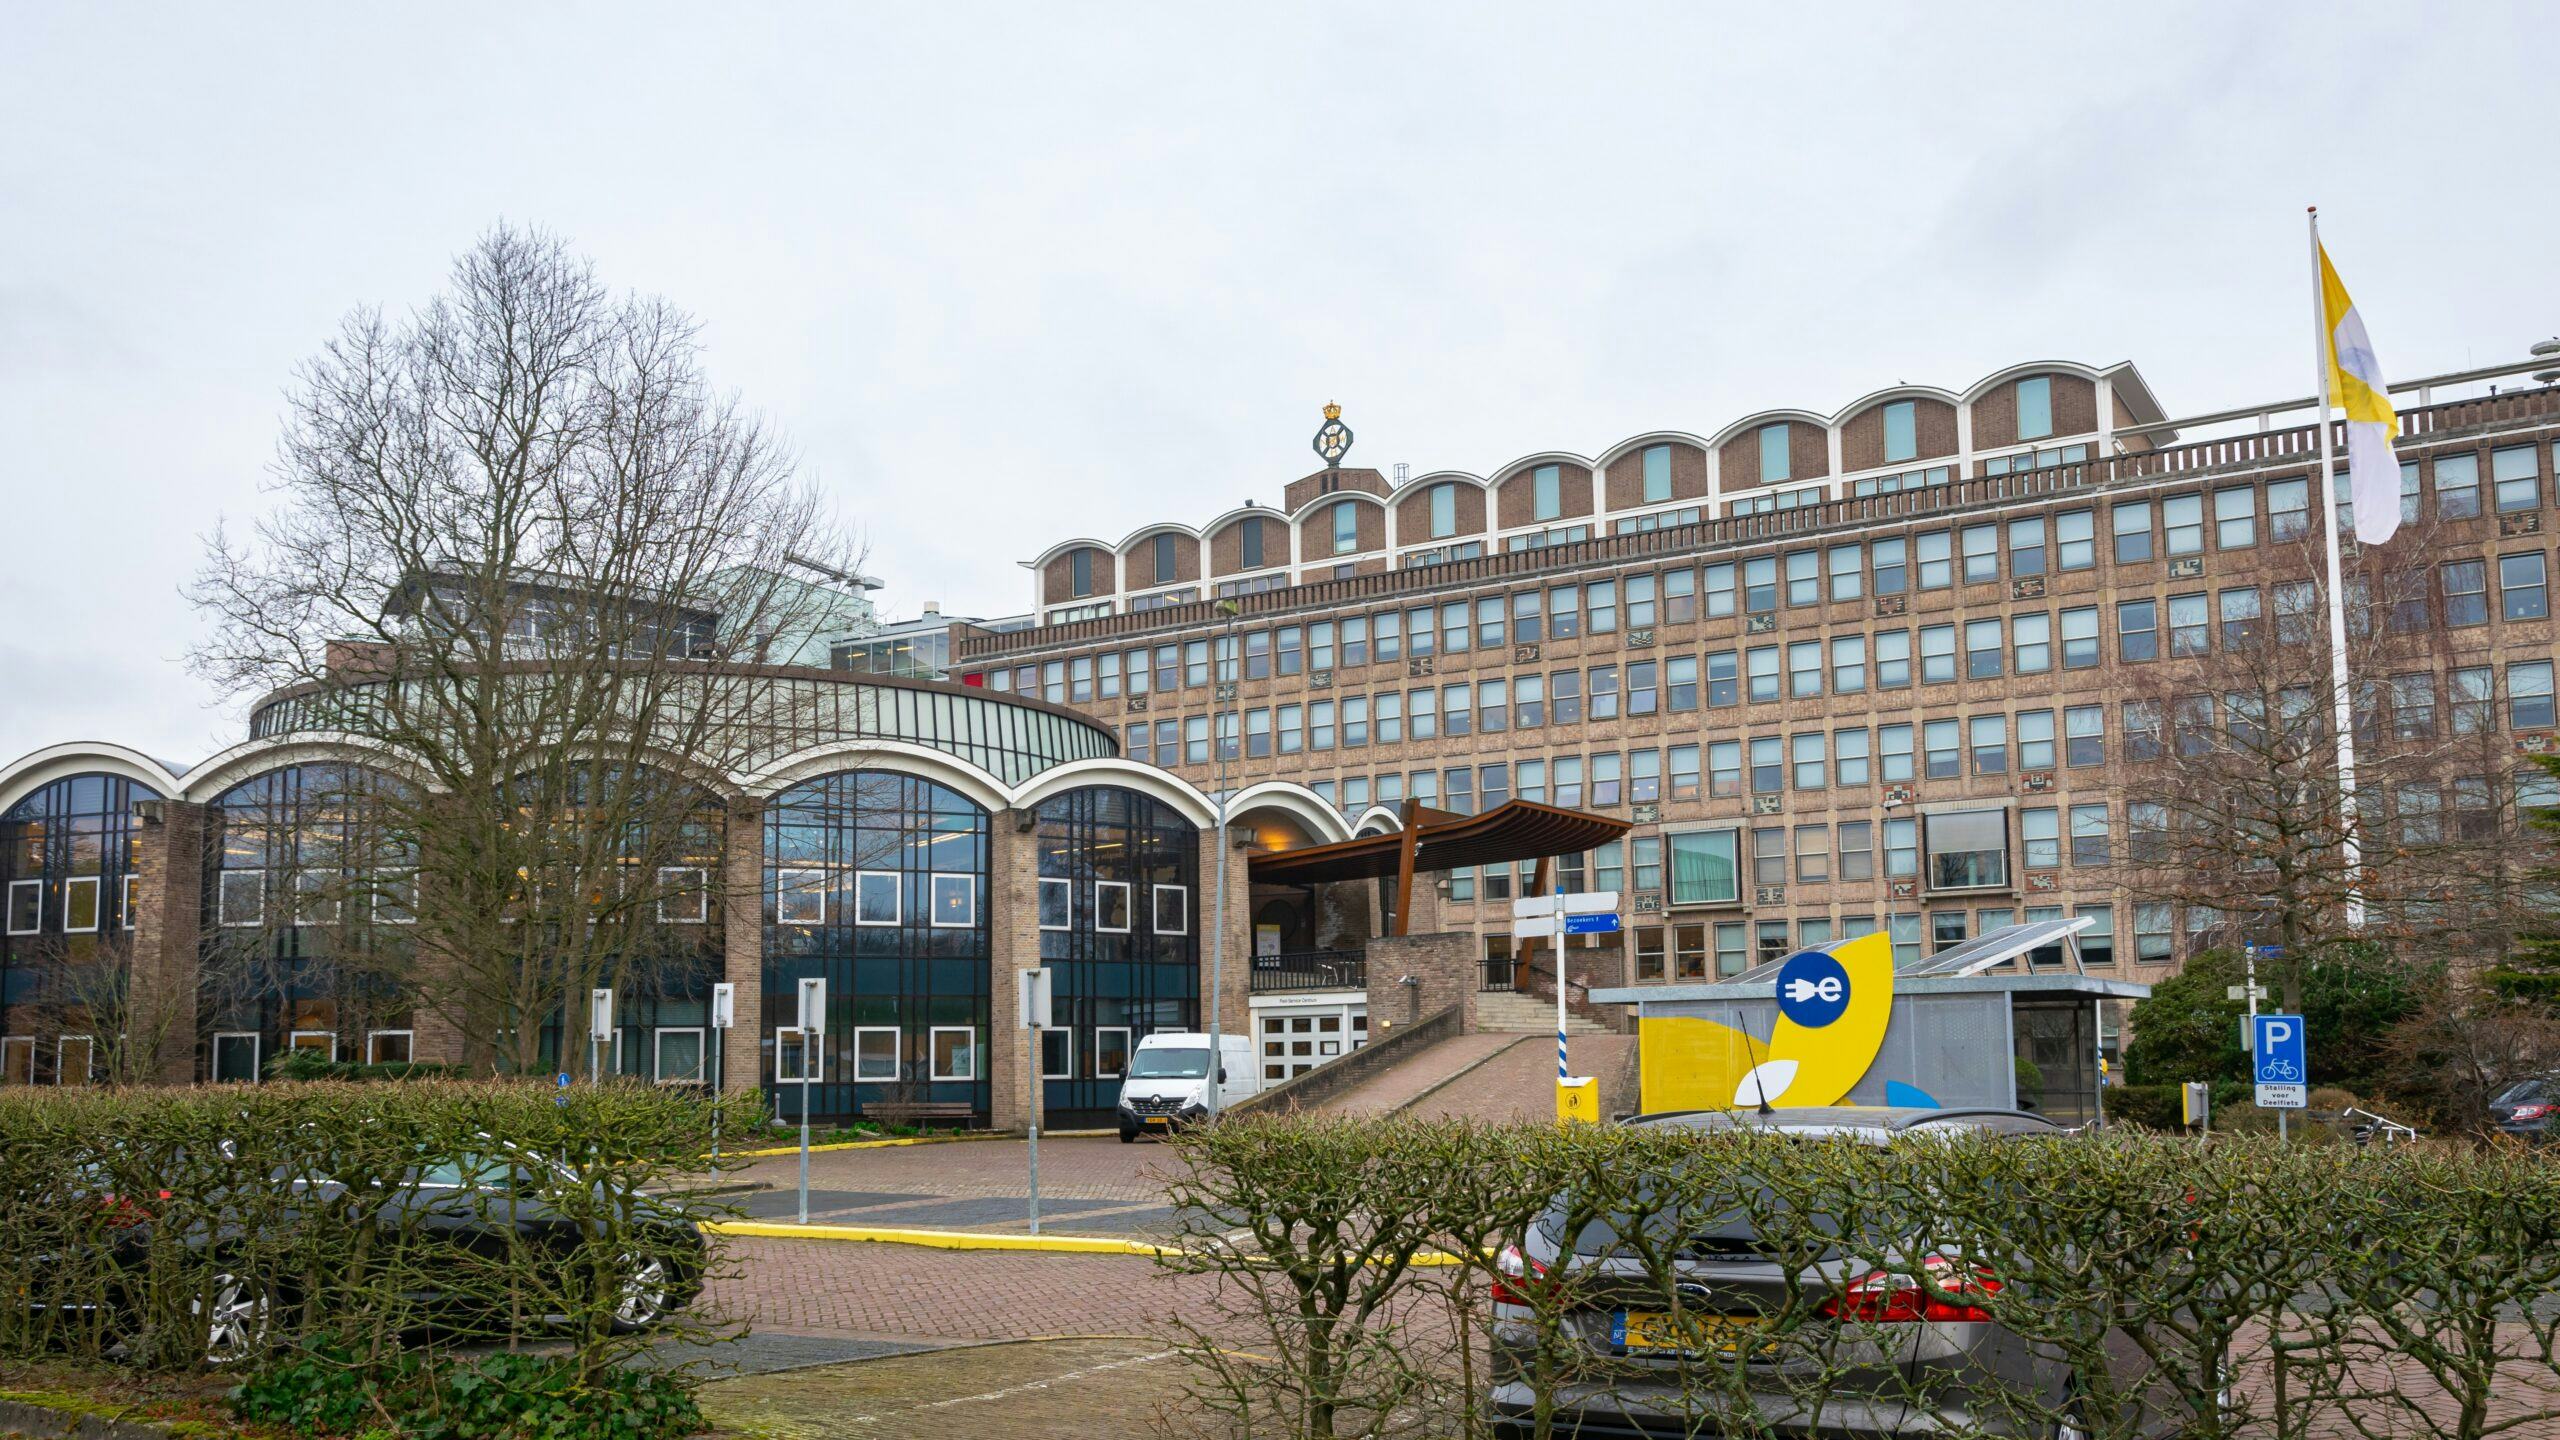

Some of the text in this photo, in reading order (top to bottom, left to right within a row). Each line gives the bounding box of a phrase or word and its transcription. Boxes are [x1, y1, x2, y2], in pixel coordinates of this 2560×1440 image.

[1818, 976, 1843, 1002] e
[2265, 1021, 2292, 1055] P
[2264, 1084, 2296, 1092] Stalling
